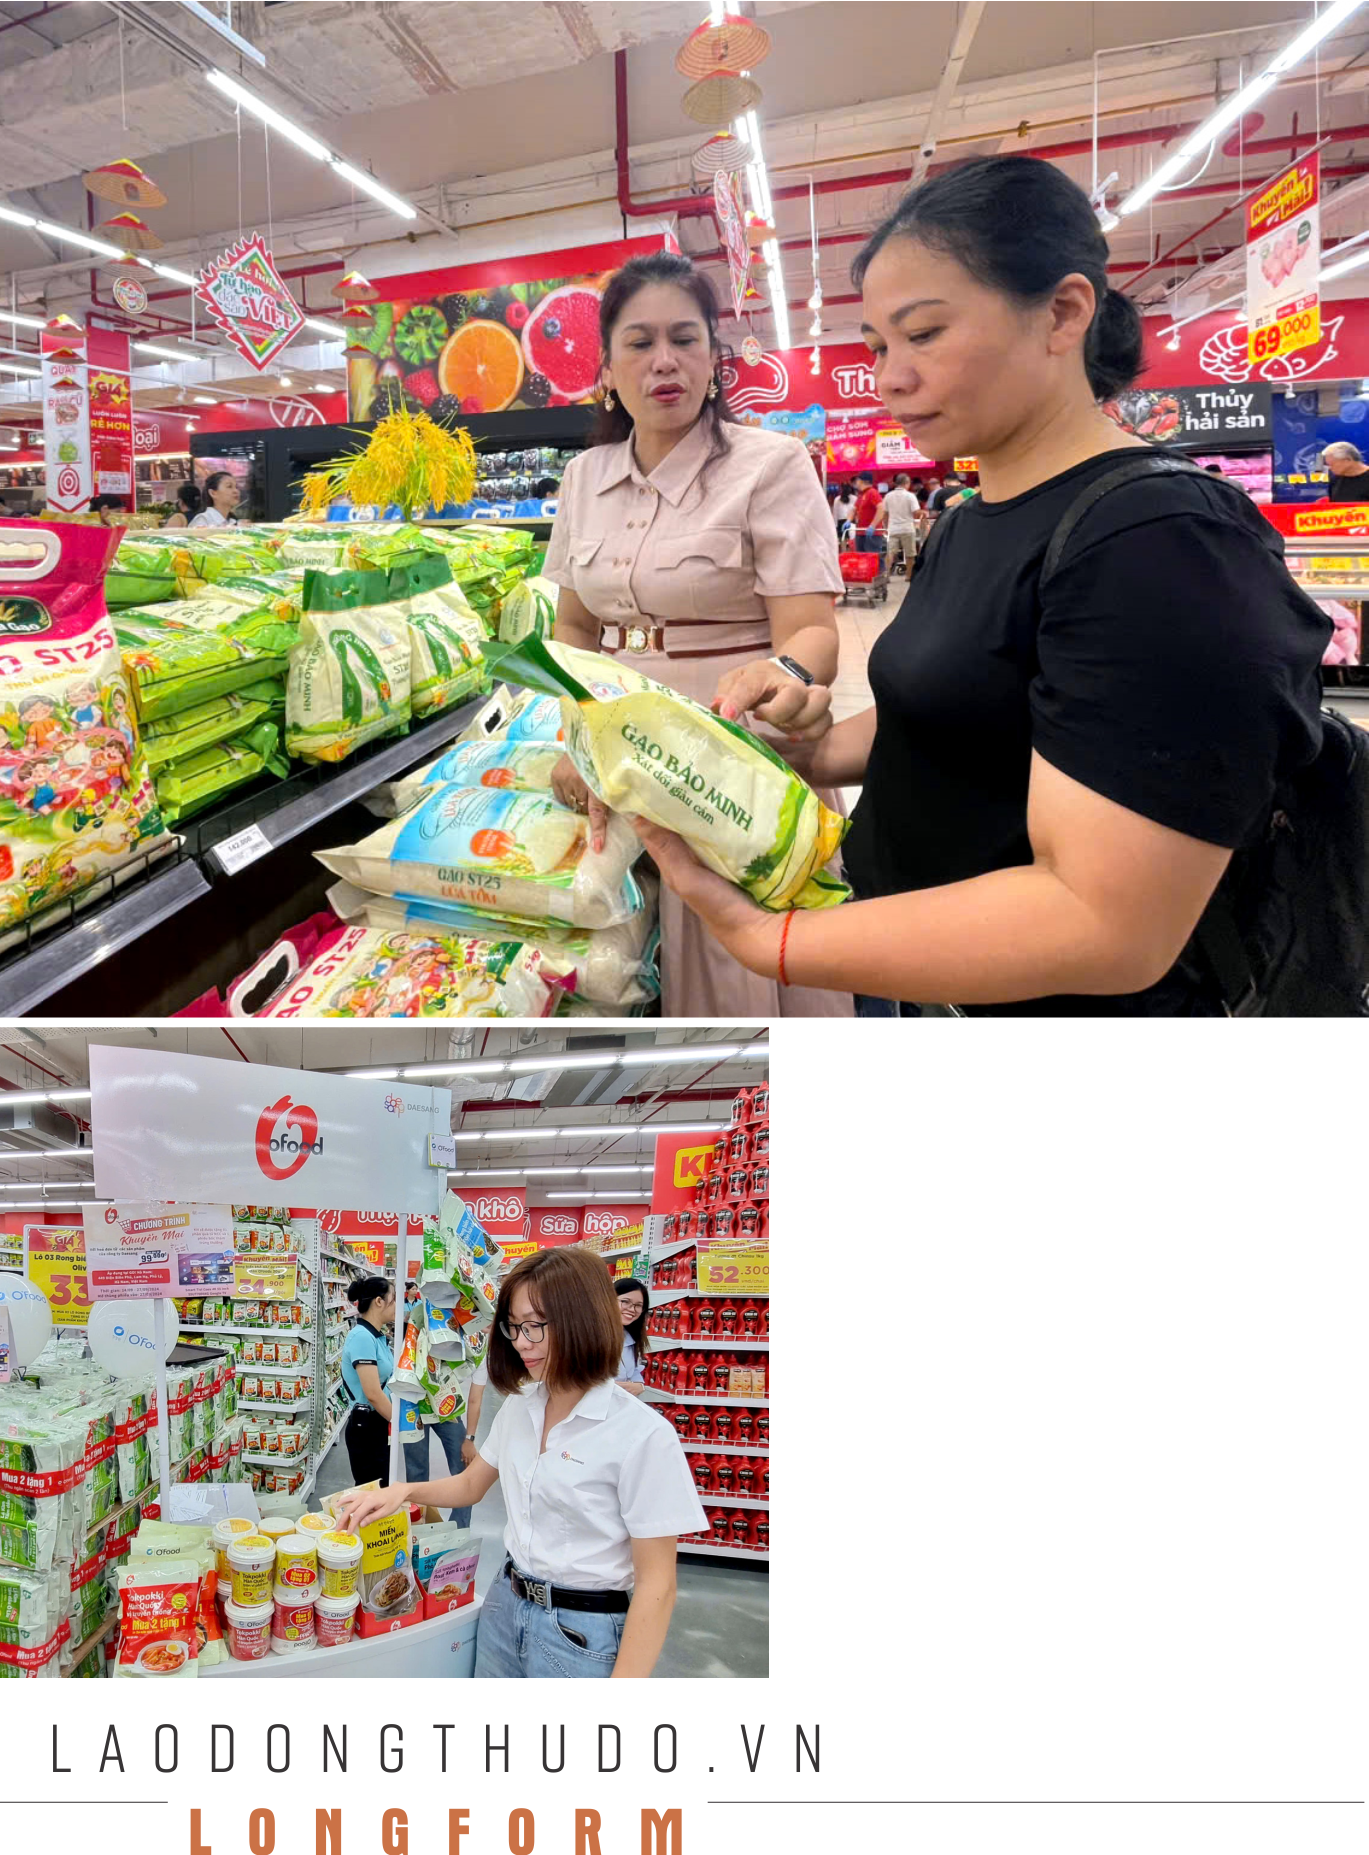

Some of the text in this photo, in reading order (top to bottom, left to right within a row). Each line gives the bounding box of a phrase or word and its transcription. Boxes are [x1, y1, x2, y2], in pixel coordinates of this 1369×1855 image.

[1196, 390, 1253, 411] Thủy
[1185, 409, 1265, 431] hải sản
[1298, 511, 1367, 529] Khuyến
[34, 628, 114, 666] ST25
[665, 754, 705, 793] BẢO
[705, 787, 753, 832] MINH
[407, 1103, 440, 1114] DAESANG
[270, 1133, 323, 1155] ofood
[480, 1198, 521, 1220] khô
[542, 1213, 625, 1235] Sữa hộp
[56, 1255, 75, 1263] Rong
[1, 1474, 18, 1484] Mua
[27, 1477, 45, 1489] tặng
[379, 1526, 395, 1537] MIẾN
[366, 1539, 390, 1549] KHOAI
[127, 1591, 164, 1602] Tokpokki
[132, 1619, 149, 1630] Mua
[160, 1618, 179, 1630] tặng
[17, 1650, 35, 1659] Mua
